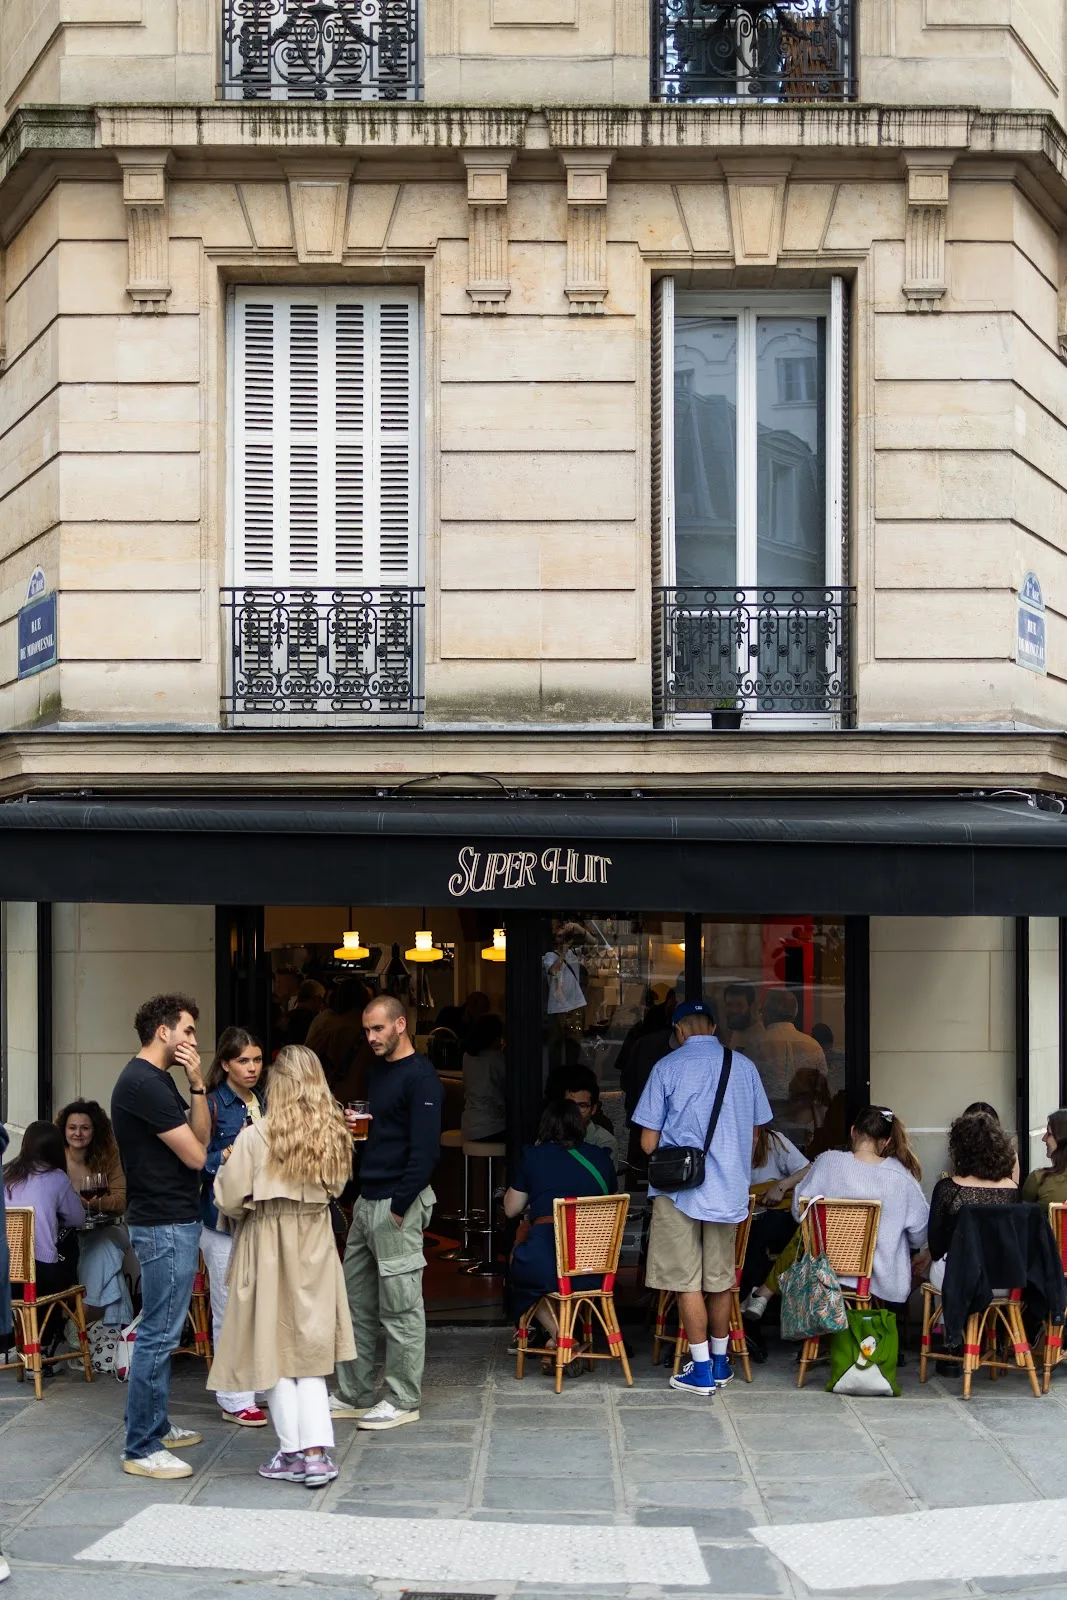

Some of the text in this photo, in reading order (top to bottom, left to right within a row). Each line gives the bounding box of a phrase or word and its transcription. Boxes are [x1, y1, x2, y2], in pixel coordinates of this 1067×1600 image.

[31, 617, 42, 634] RUE
[20, 646, 27, 661] DE
[448, 846, 613, 897] SUPER HUIT
